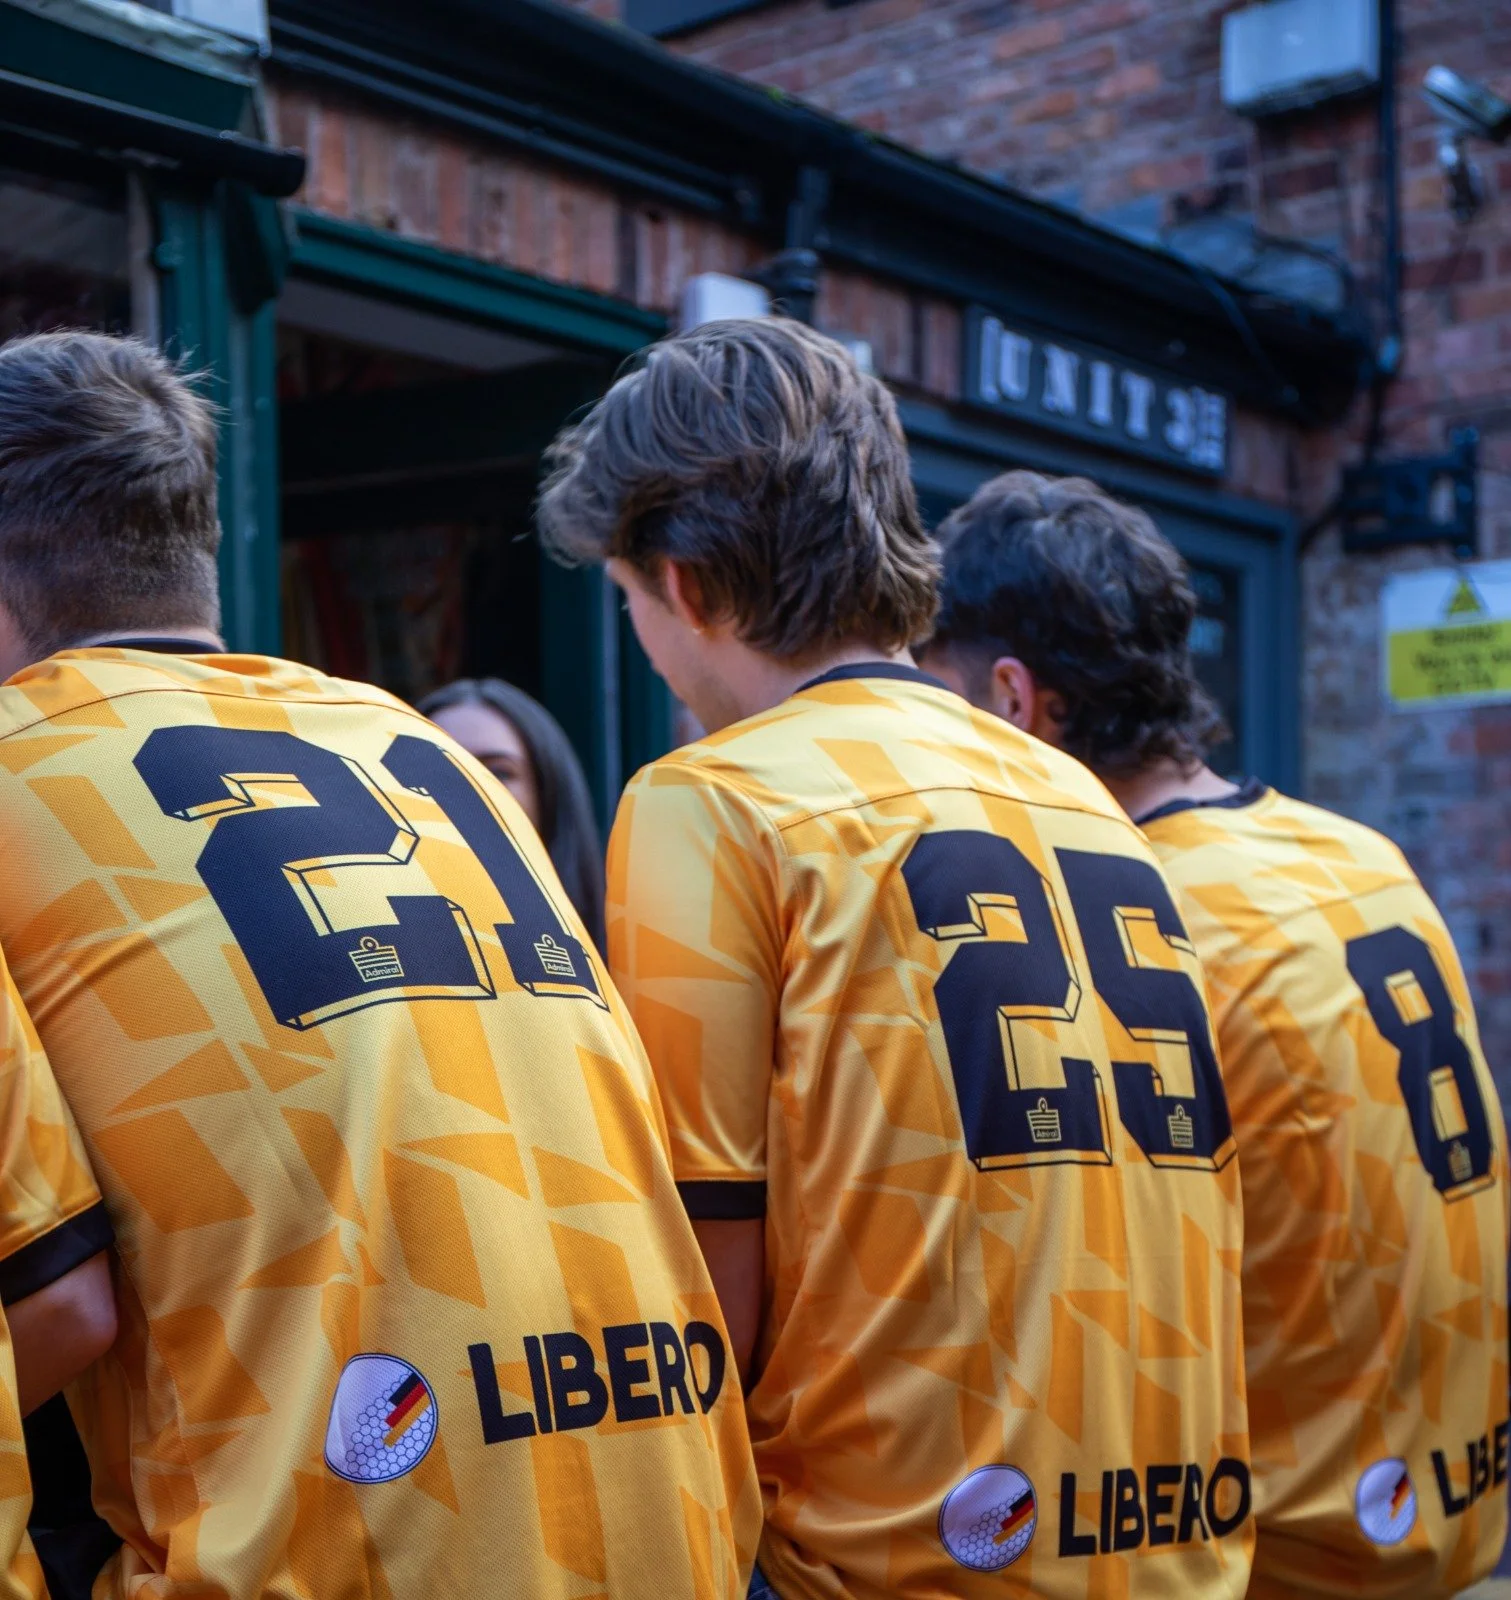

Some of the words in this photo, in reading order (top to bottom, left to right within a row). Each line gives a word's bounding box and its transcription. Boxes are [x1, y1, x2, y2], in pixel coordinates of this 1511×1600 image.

[998, 328, 1154, 439] UNIT
[132, 725, 610, 1032] 21
[365, 963, 399, 978] Admiral
[547, 962, 572, 974] Admiral
[900, 829, 1237, 1173] 25
[1345, 923, 1497, 1205] 8
[467, 1320, 726, 1445] LIBERO
[1058, 1457, 1252, 1558] LIBERO
